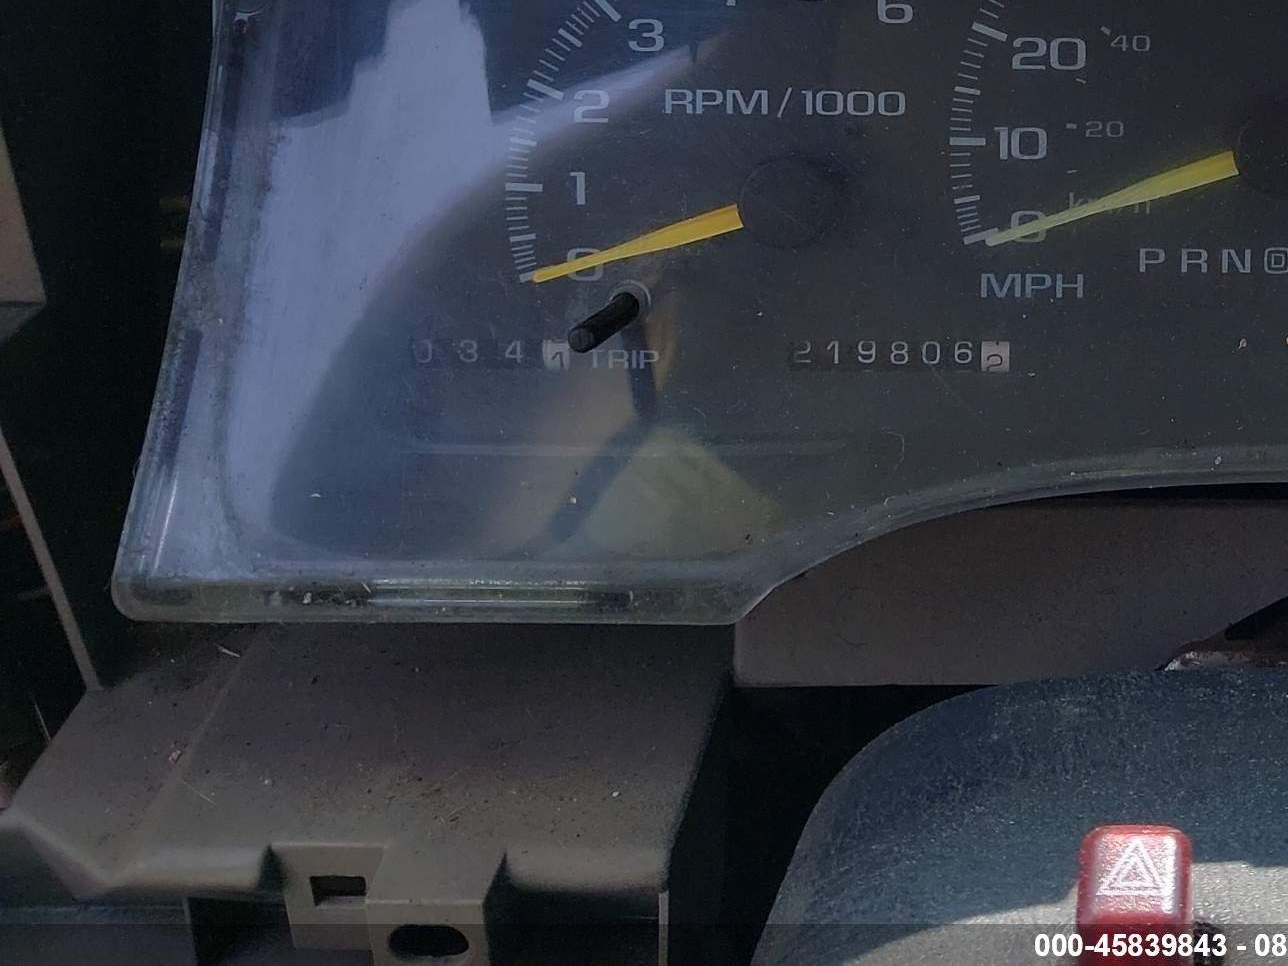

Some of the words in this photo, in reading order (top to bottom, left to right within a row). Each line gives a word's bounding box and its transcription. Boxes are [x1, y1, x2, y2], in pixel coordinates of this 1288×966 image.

[628, 19, 665, 52] 3
[1110, 34, 1150, 51] 40
[1012, 38, 1086, 70] 20
[573, 90, 609, 122] 2
[994, 127, 1047, 159] 10
[1085, 121, 1124, 137] 20
[570, 172, 585, 205] 1
[980, 273, 1084, 298] MPH
[591, 349, 659, 369] TRIP
